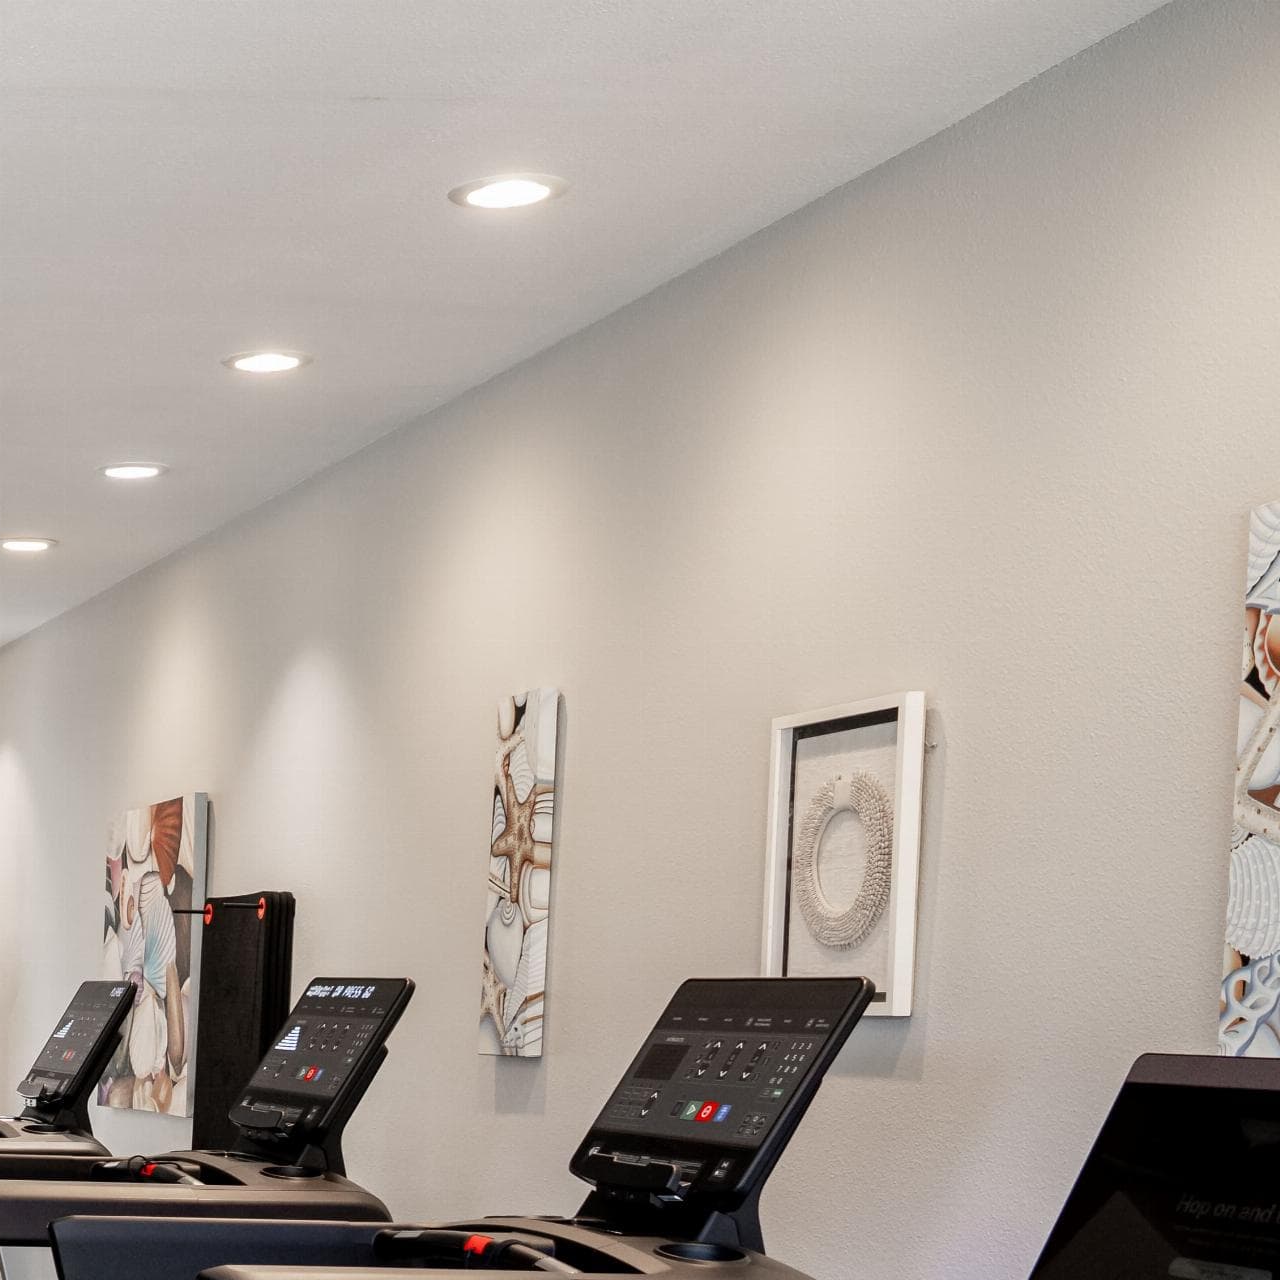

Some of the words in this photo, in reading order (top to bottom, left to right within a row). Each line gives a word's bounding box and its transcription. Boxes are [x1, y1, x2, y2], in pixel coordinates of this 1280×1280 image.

[1175, 1193, 1210, 1220] Hop
[1213, 1202, 1236, 1217] on
[1238, 1203, 1277, 1224] and
